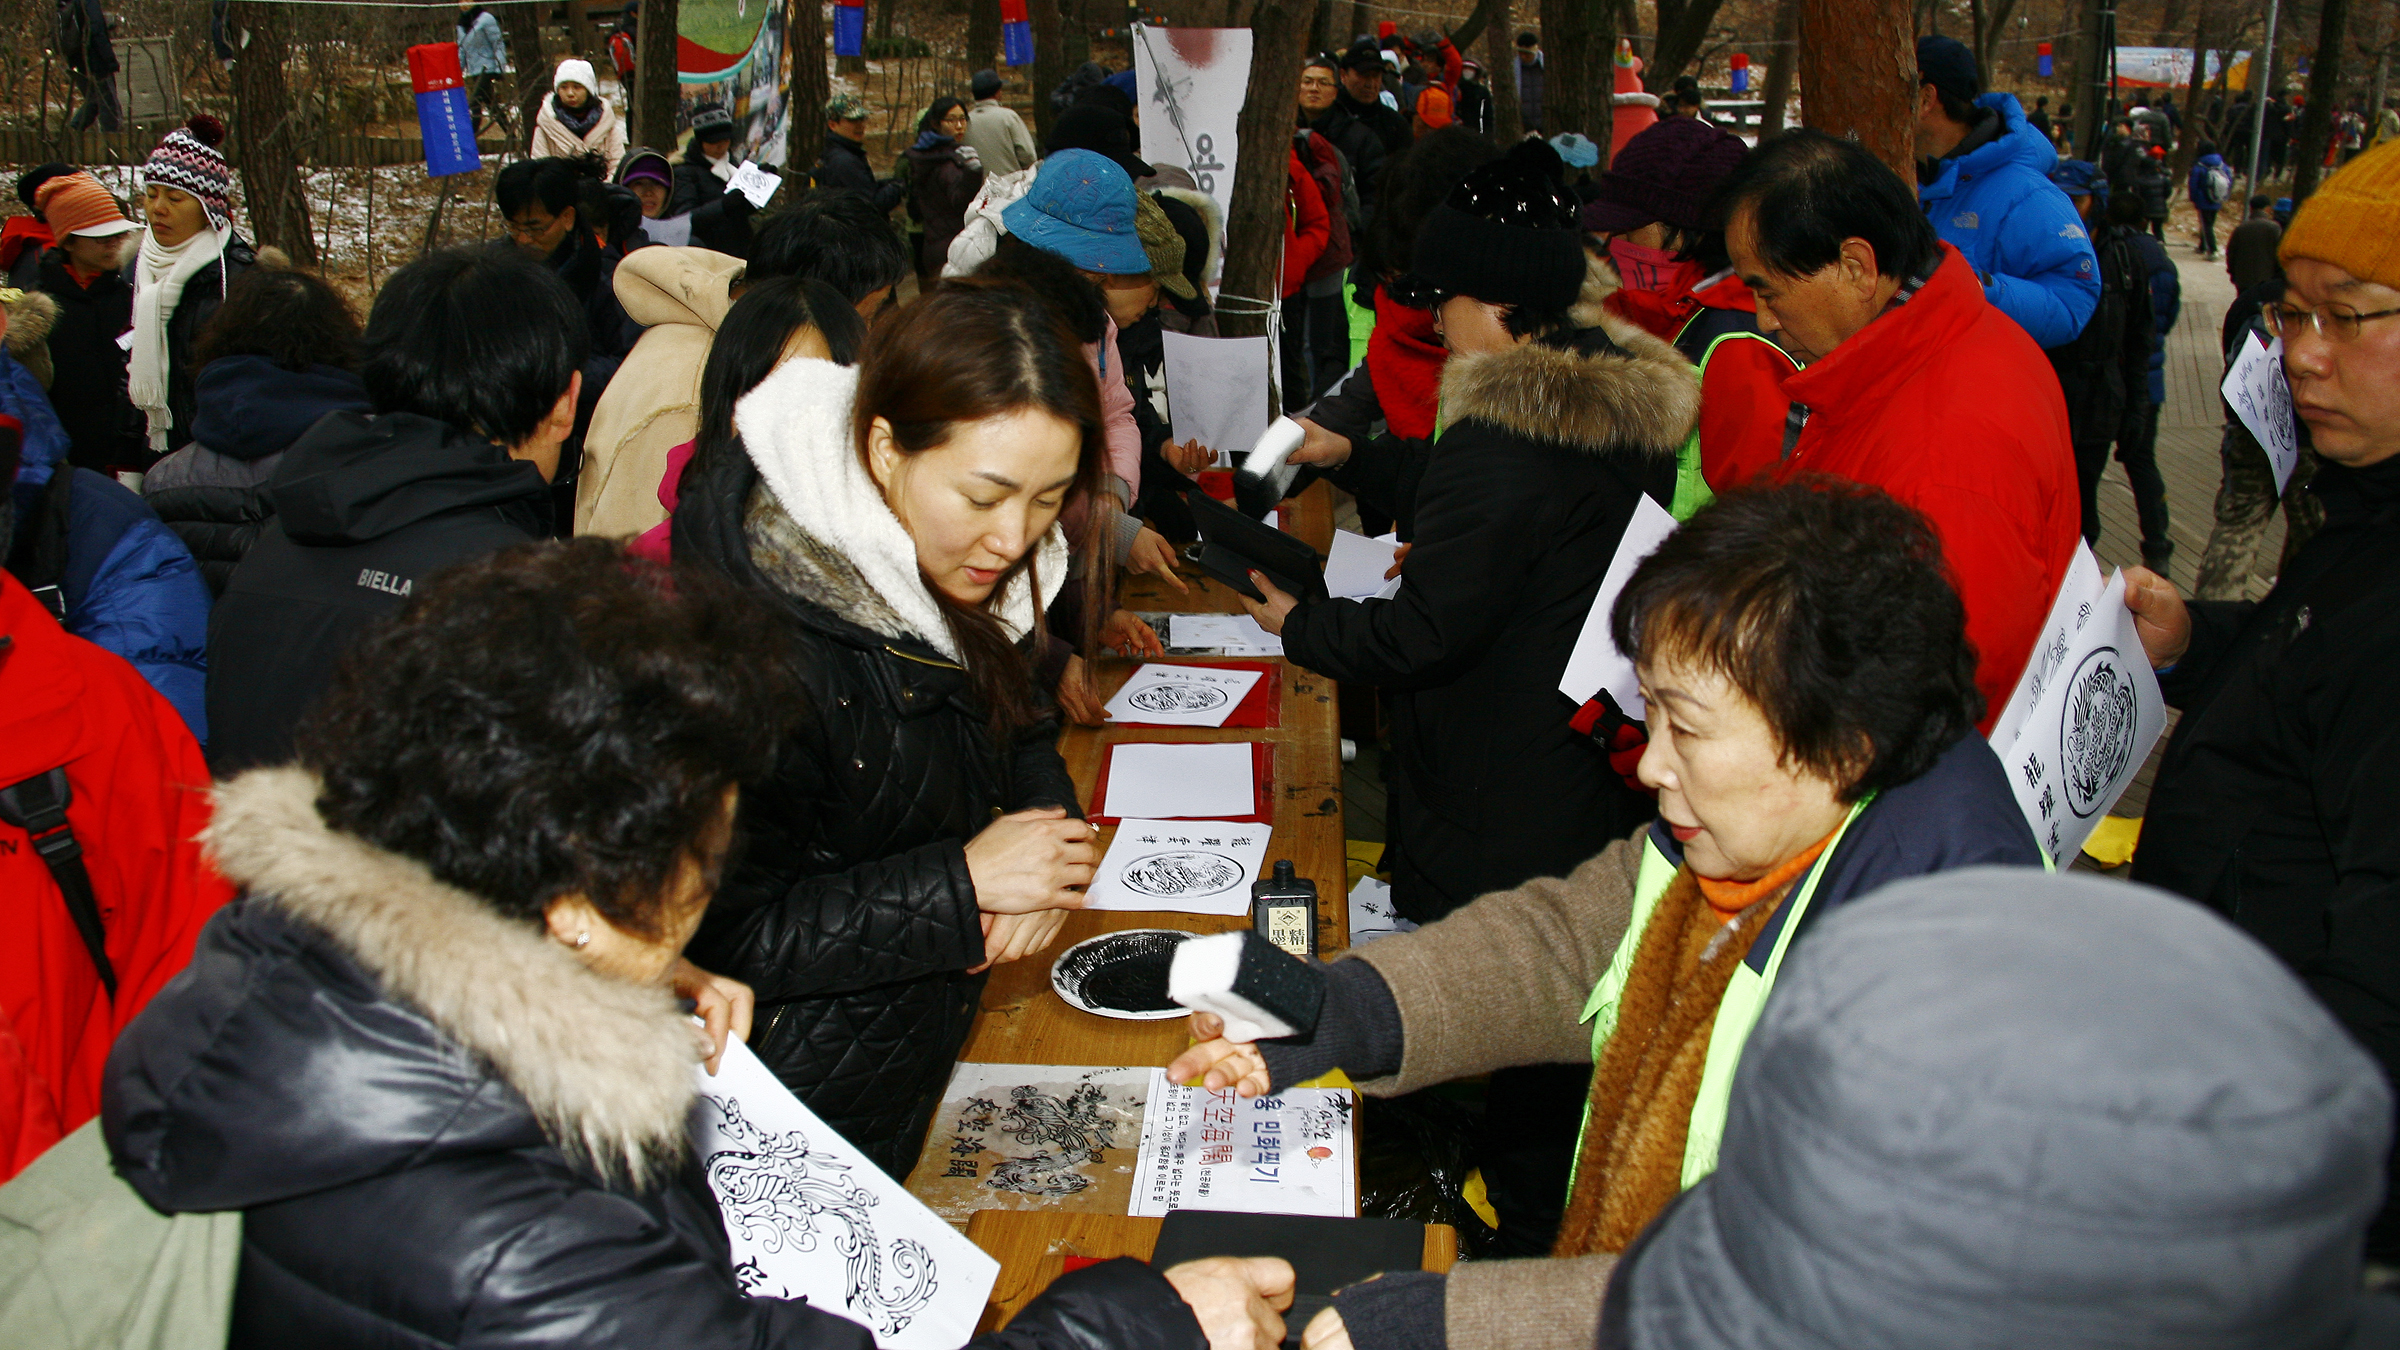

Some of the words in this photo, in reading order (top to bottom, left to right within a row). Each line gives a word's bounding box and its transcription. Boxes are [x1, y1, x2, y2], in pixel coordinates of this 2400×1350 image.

[357, 568, 412, 597] BIELLA
[1254, 1096, 1285, 1111] 용
[1250, 1121, 1281, 1183] 민화찍기
